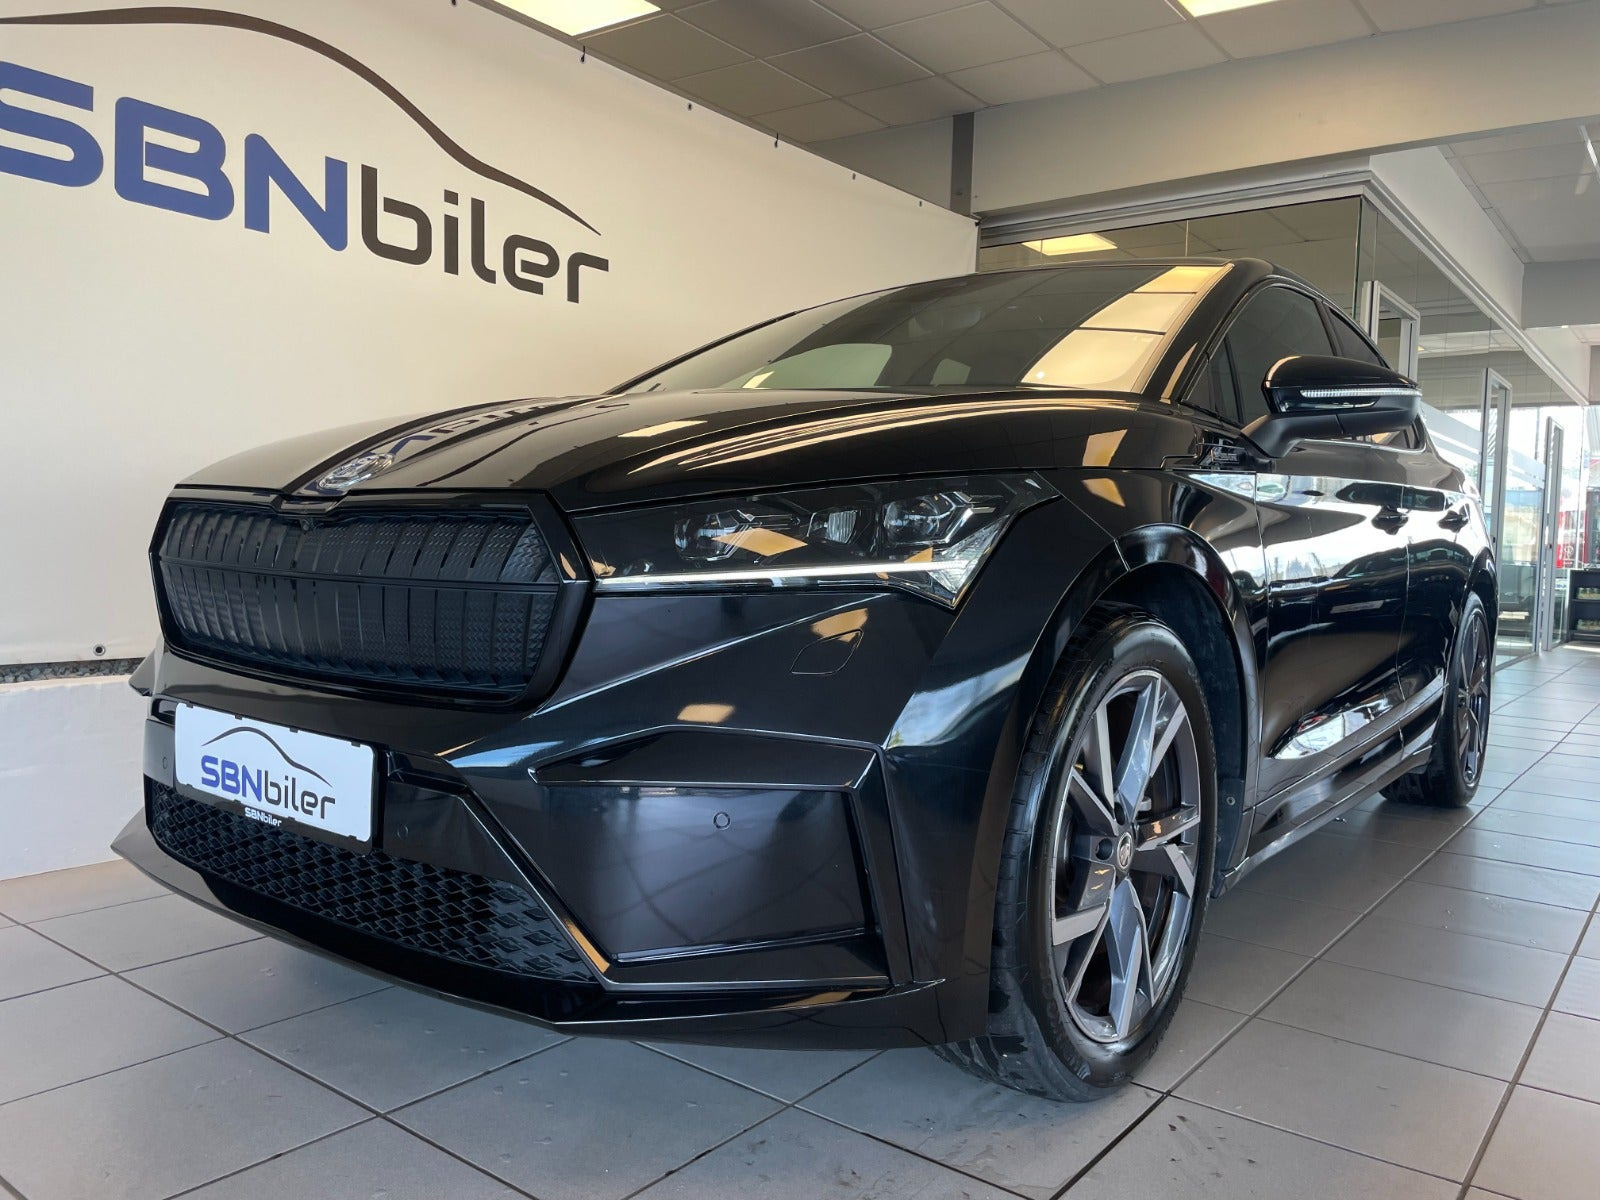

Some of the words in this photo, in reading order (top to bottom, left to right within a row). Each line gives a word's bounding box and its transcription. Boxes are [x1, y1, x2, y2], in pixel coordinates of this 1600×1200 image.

[0, 61, 609, 303] SBNbiler
[201, 755, 336, 820] SBNbiler
[244, 806, 283, 827] SBNbiler
